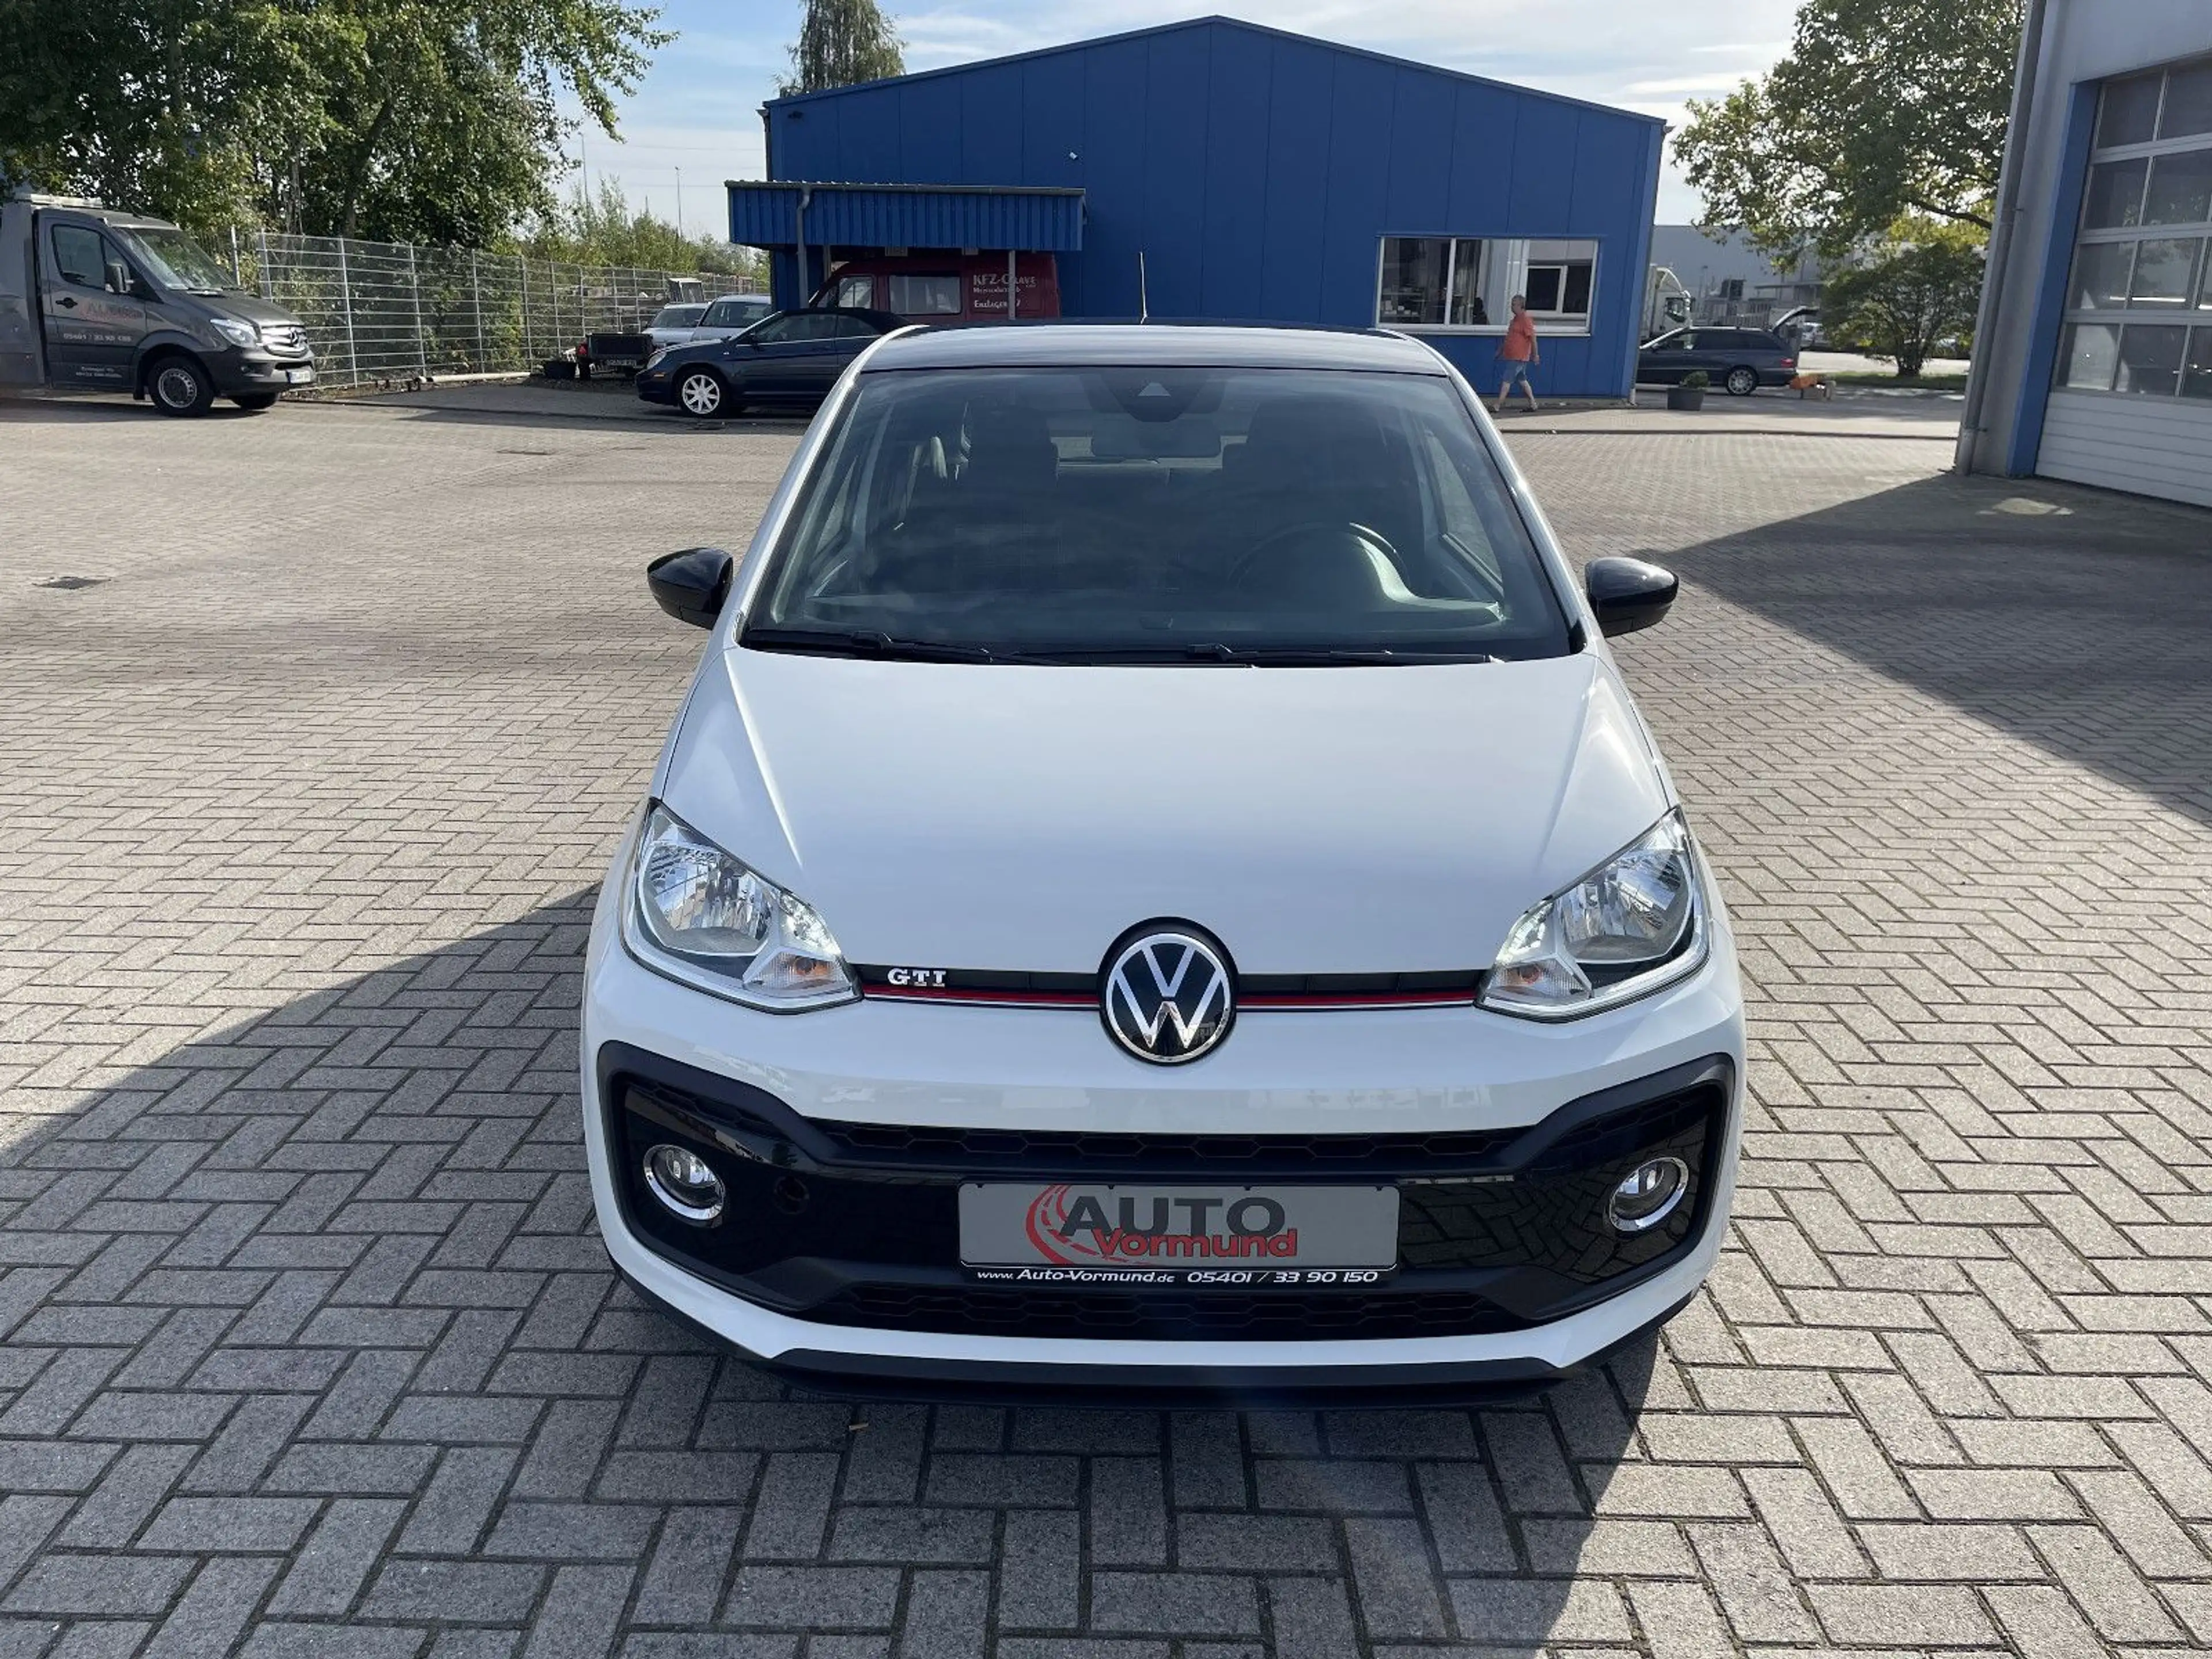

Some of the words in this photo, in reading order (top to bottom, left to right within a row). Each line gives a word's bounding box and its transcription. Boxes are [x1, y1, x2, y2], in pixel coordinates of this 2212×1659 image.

[888, 968, 946, 987] GTI
[1060, 1196, 1286, 1237] AUTO
[1092, 1227, 1298, 1258] Vormund
[1187, 1271, 1252, 1283] 05401
[1273, 1271, 1300, 1283] 33
[1306, 1271, 1337, 1283] 90
[1342, 1271, 1378, 1283] 150
